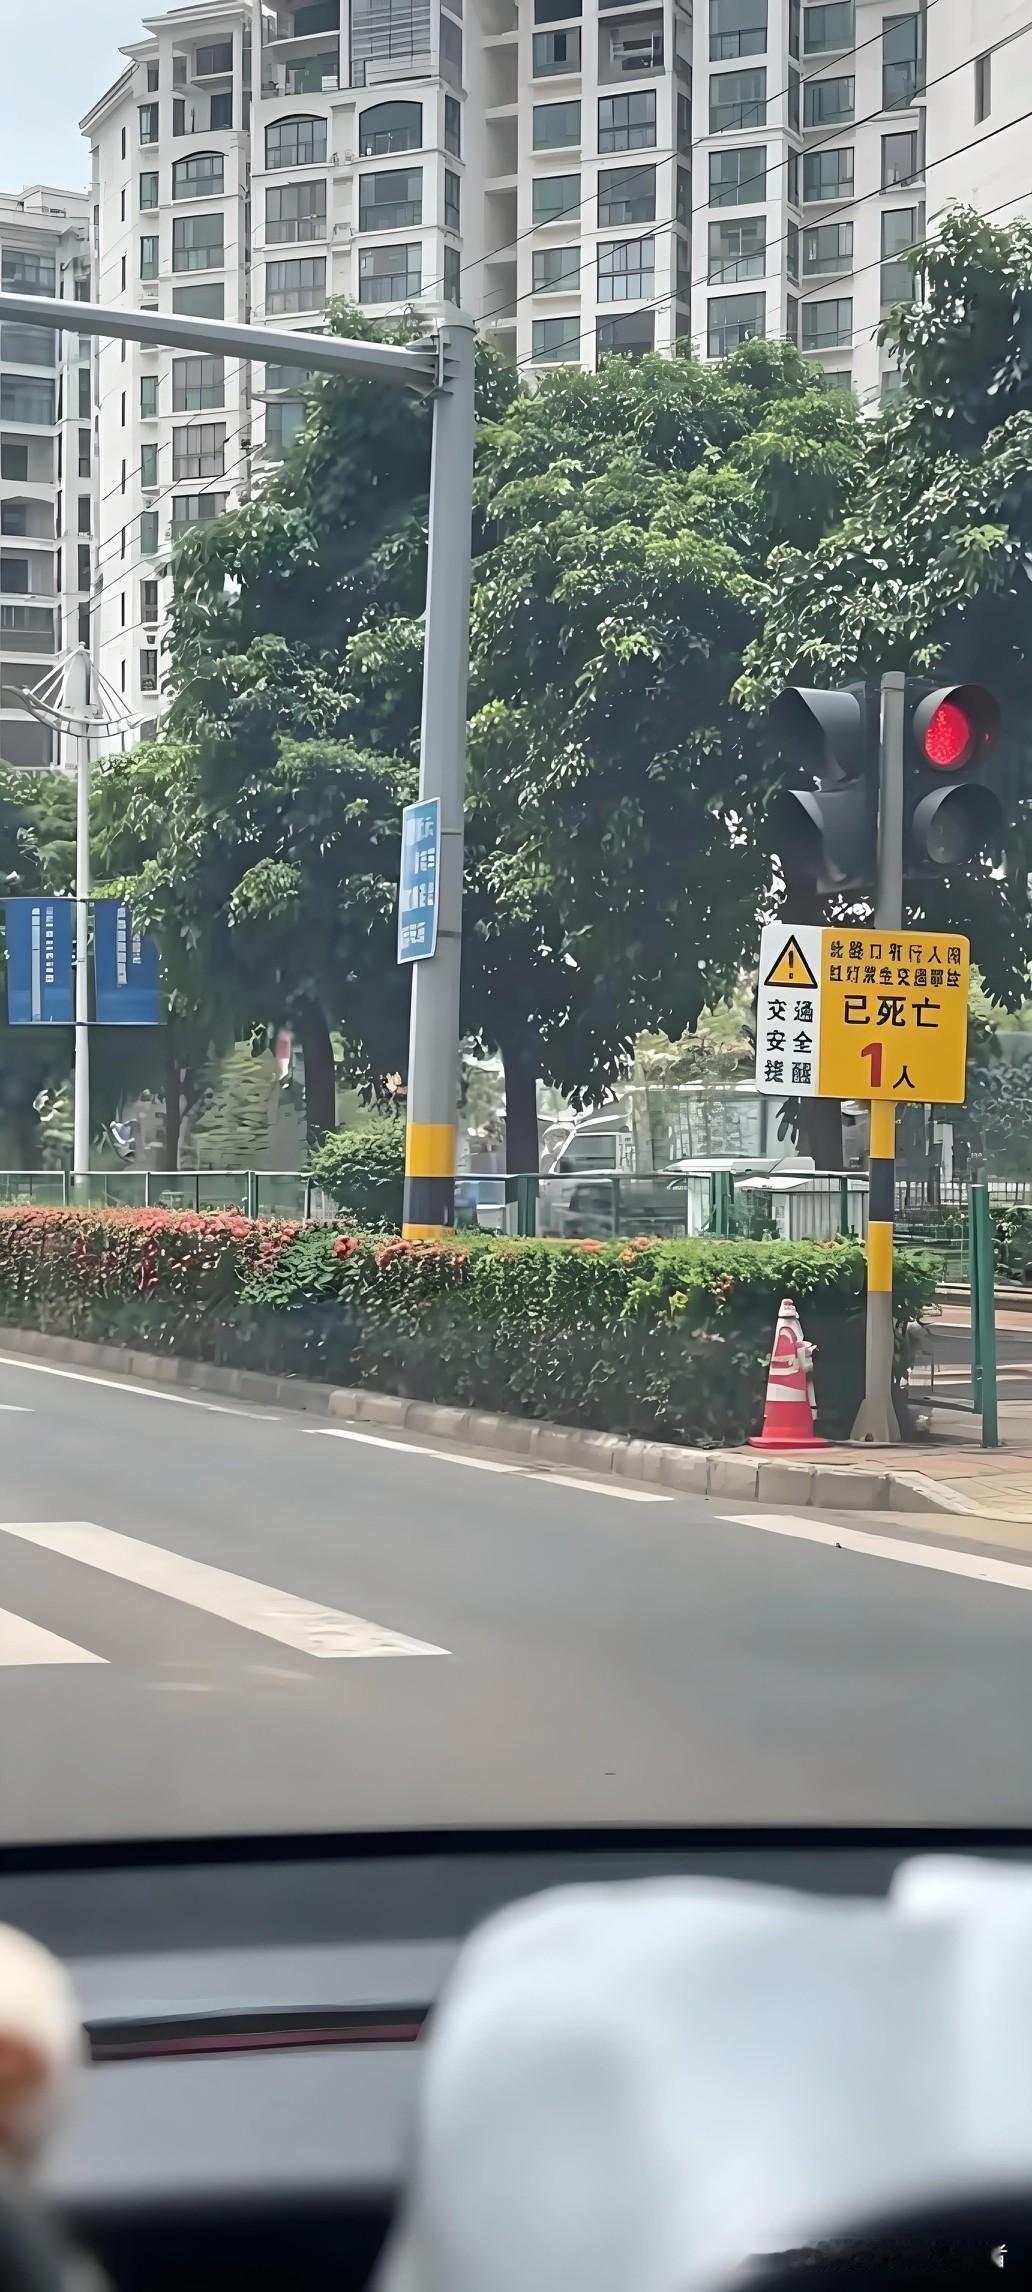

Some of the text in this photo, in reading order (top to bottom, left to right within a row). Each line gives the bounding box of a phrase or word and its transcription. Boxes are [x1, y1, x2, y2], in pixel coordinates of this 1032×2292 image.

[767, 999, 813, 1022] 交通
[844, 995, 940, 1027] 已死亡
[766, 1030, 812, 1053] 安全
